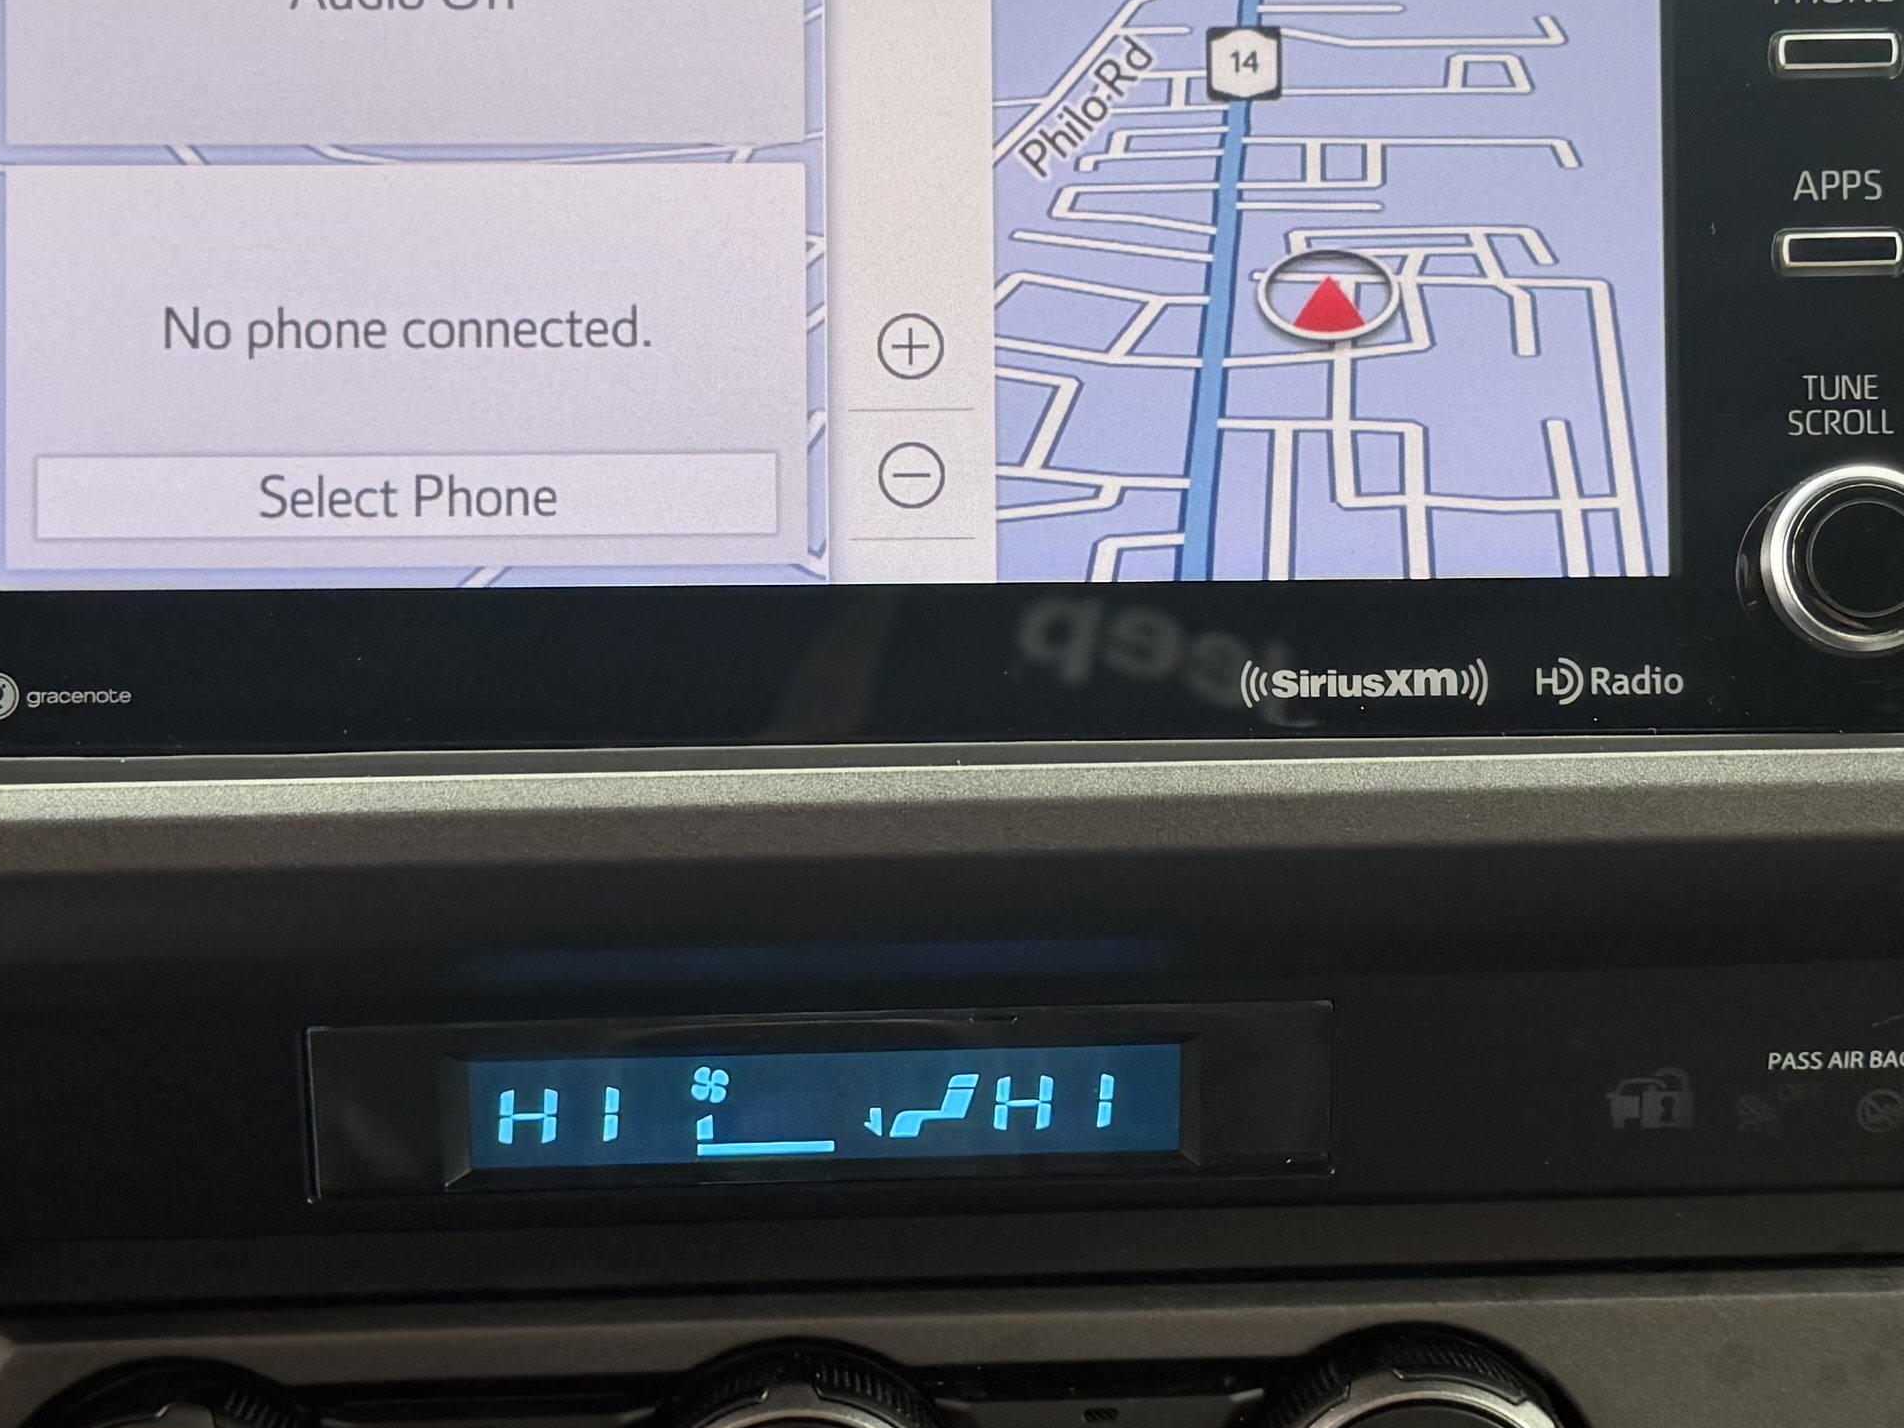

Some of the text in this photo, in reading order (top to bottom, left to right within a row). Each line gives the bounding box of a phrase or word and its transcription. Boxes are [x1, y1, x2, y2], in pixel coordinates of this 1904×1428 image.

[1230, 50, 1259, 73] 14
[1018, 35, 1154, 178] Philo Rd
[1793, 169, 1883, 201] APPS
[163, 304, 652, 360] No phone connected.
[1802, 374, 1879, 401] TUNE
[1787, 408, 1894, 436] SCROLL
[258, 473, 559, 520] Select Phone
[1590, 665, 1684, 696] Radio
[26, 689, 132, 710] gracenote
[1767, 1051, 1823, 1070] PASS
[1827, 1051, 1863, 1069] AIR
